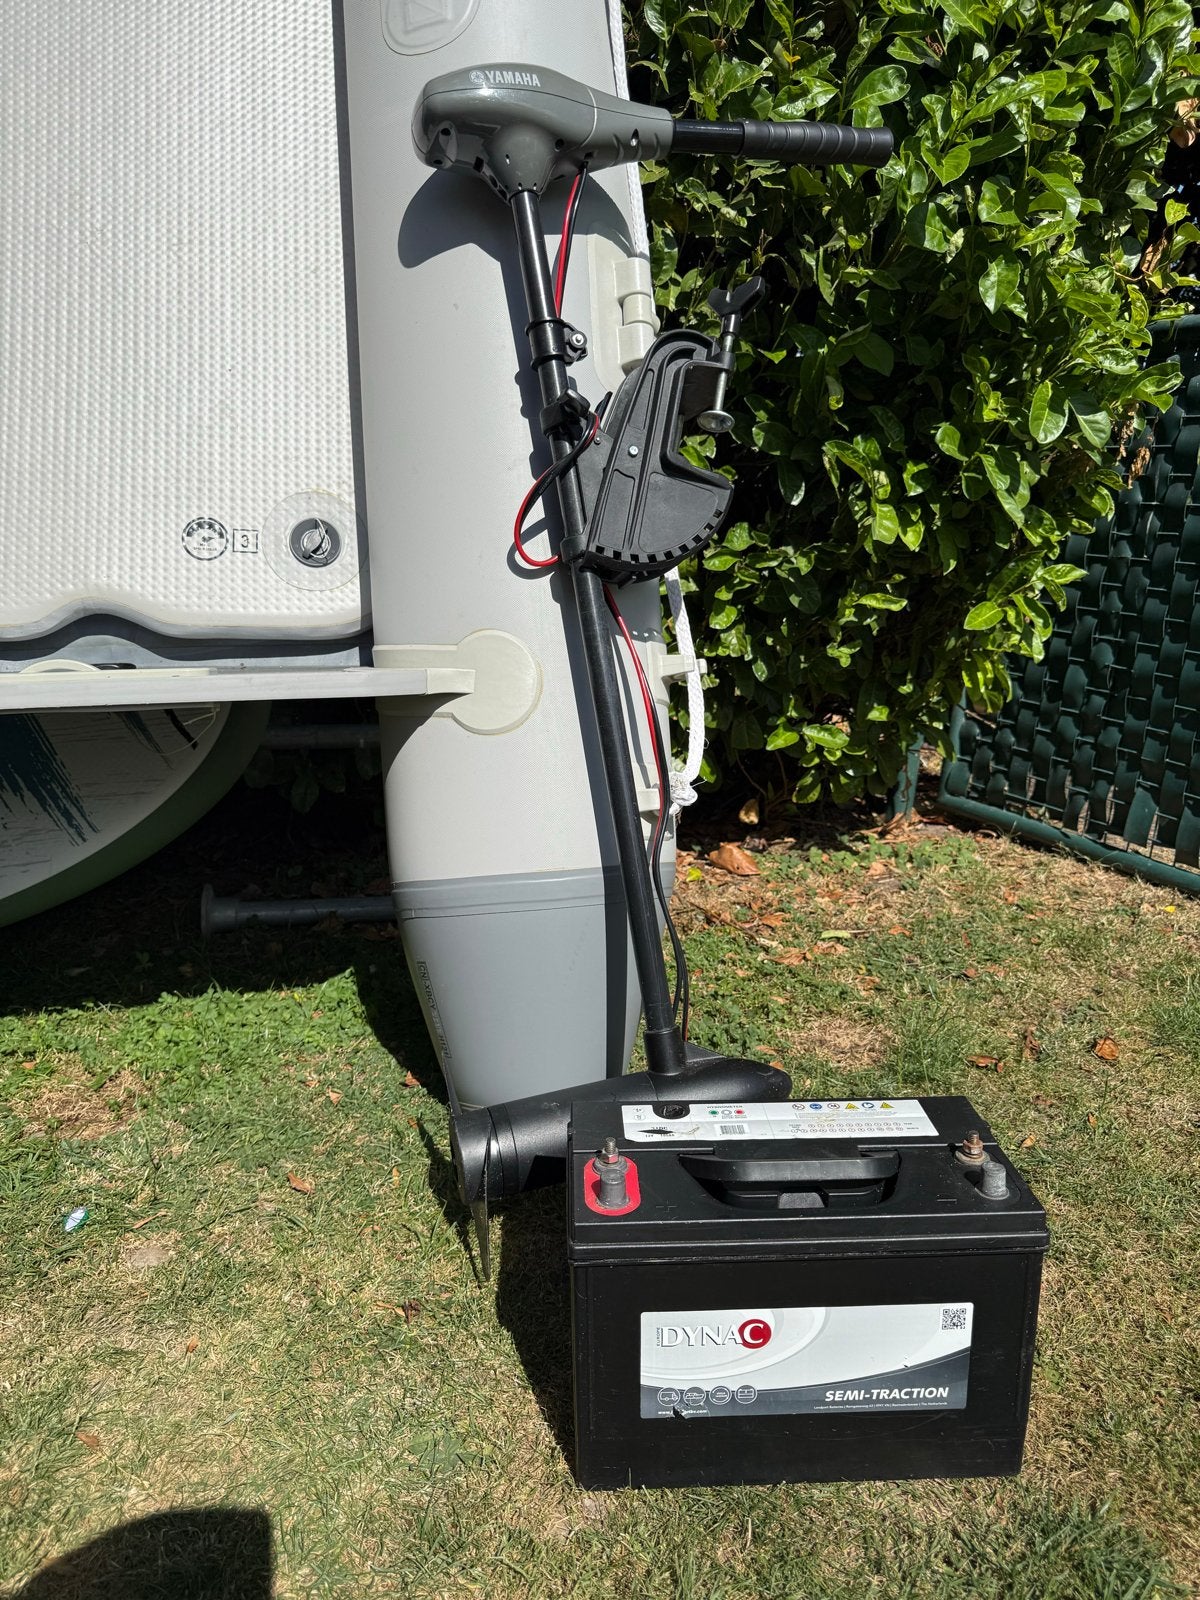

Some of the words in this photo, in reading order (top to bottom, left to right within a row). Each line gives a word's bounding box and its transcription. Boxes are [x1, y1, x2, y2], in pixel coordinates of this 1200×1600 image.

[485, 70, 541, 87] YAMAHA
[241, 534, 250, 548] 3
[660, 1323, 765, 1348] DYNAC
[825, 1387, 949, 1401] SEMI-TRACTION
